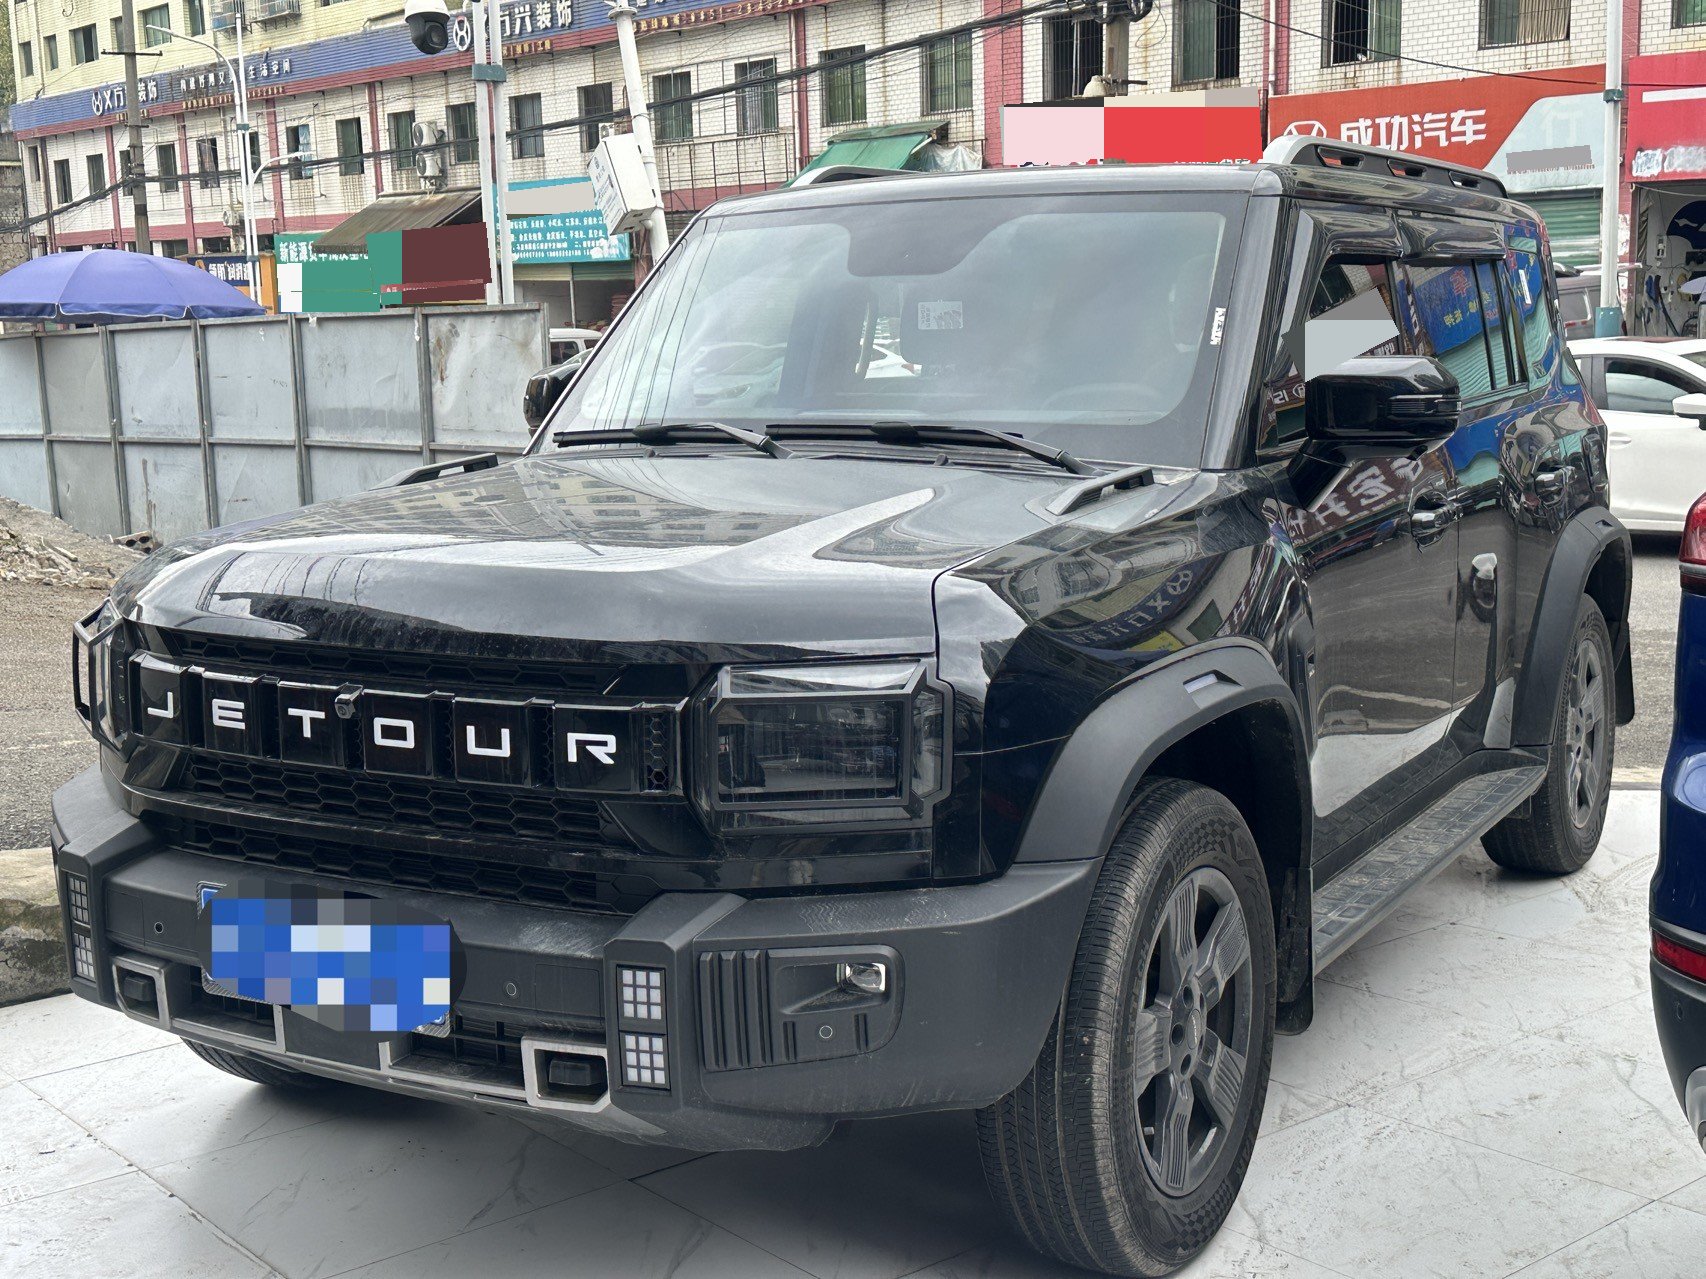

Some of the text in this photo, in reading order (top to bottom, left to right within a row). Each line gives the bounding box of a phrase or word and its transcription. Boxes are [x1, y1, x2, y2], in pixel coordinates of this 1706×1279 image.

[484, 0, 572, 37] 方兴装饰
[1341, 109, 1487, 151] 成功汽车
[147, 691, 618, 766] JETOUR
